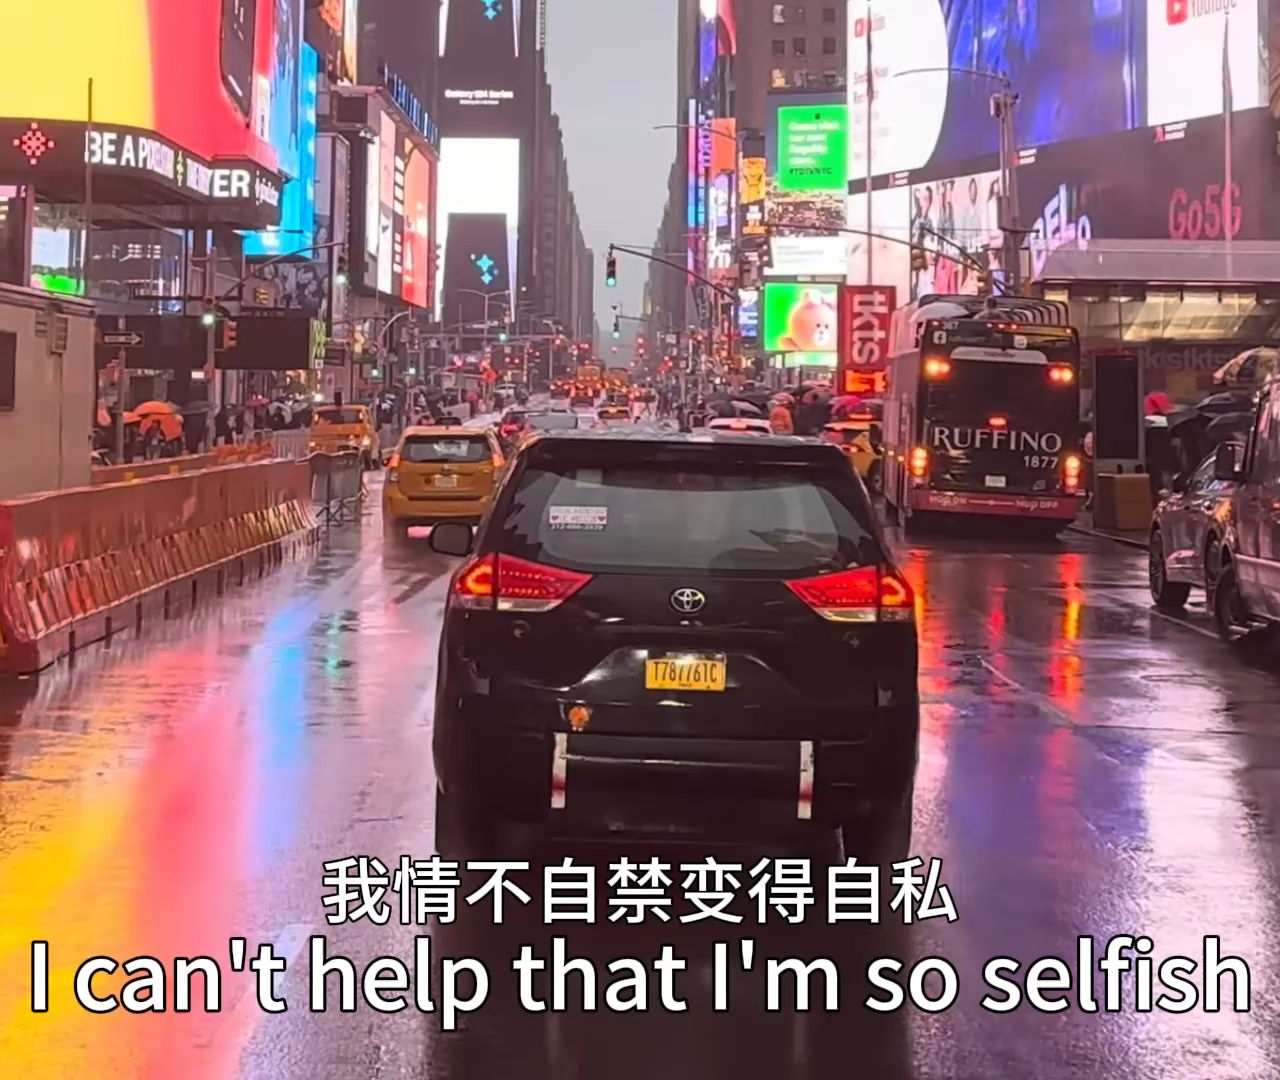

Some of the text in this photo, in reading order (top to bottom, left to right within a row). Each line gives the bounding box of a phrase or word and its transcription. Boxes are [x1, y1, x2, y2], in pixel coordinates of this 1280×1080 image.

[1168, 182, 1243, 243] Go5G
[852, 291, 888, 365] tkts
[933, 426, 1062, 453] RUFFINO
[1023, 455, 1059, 470] 1877
